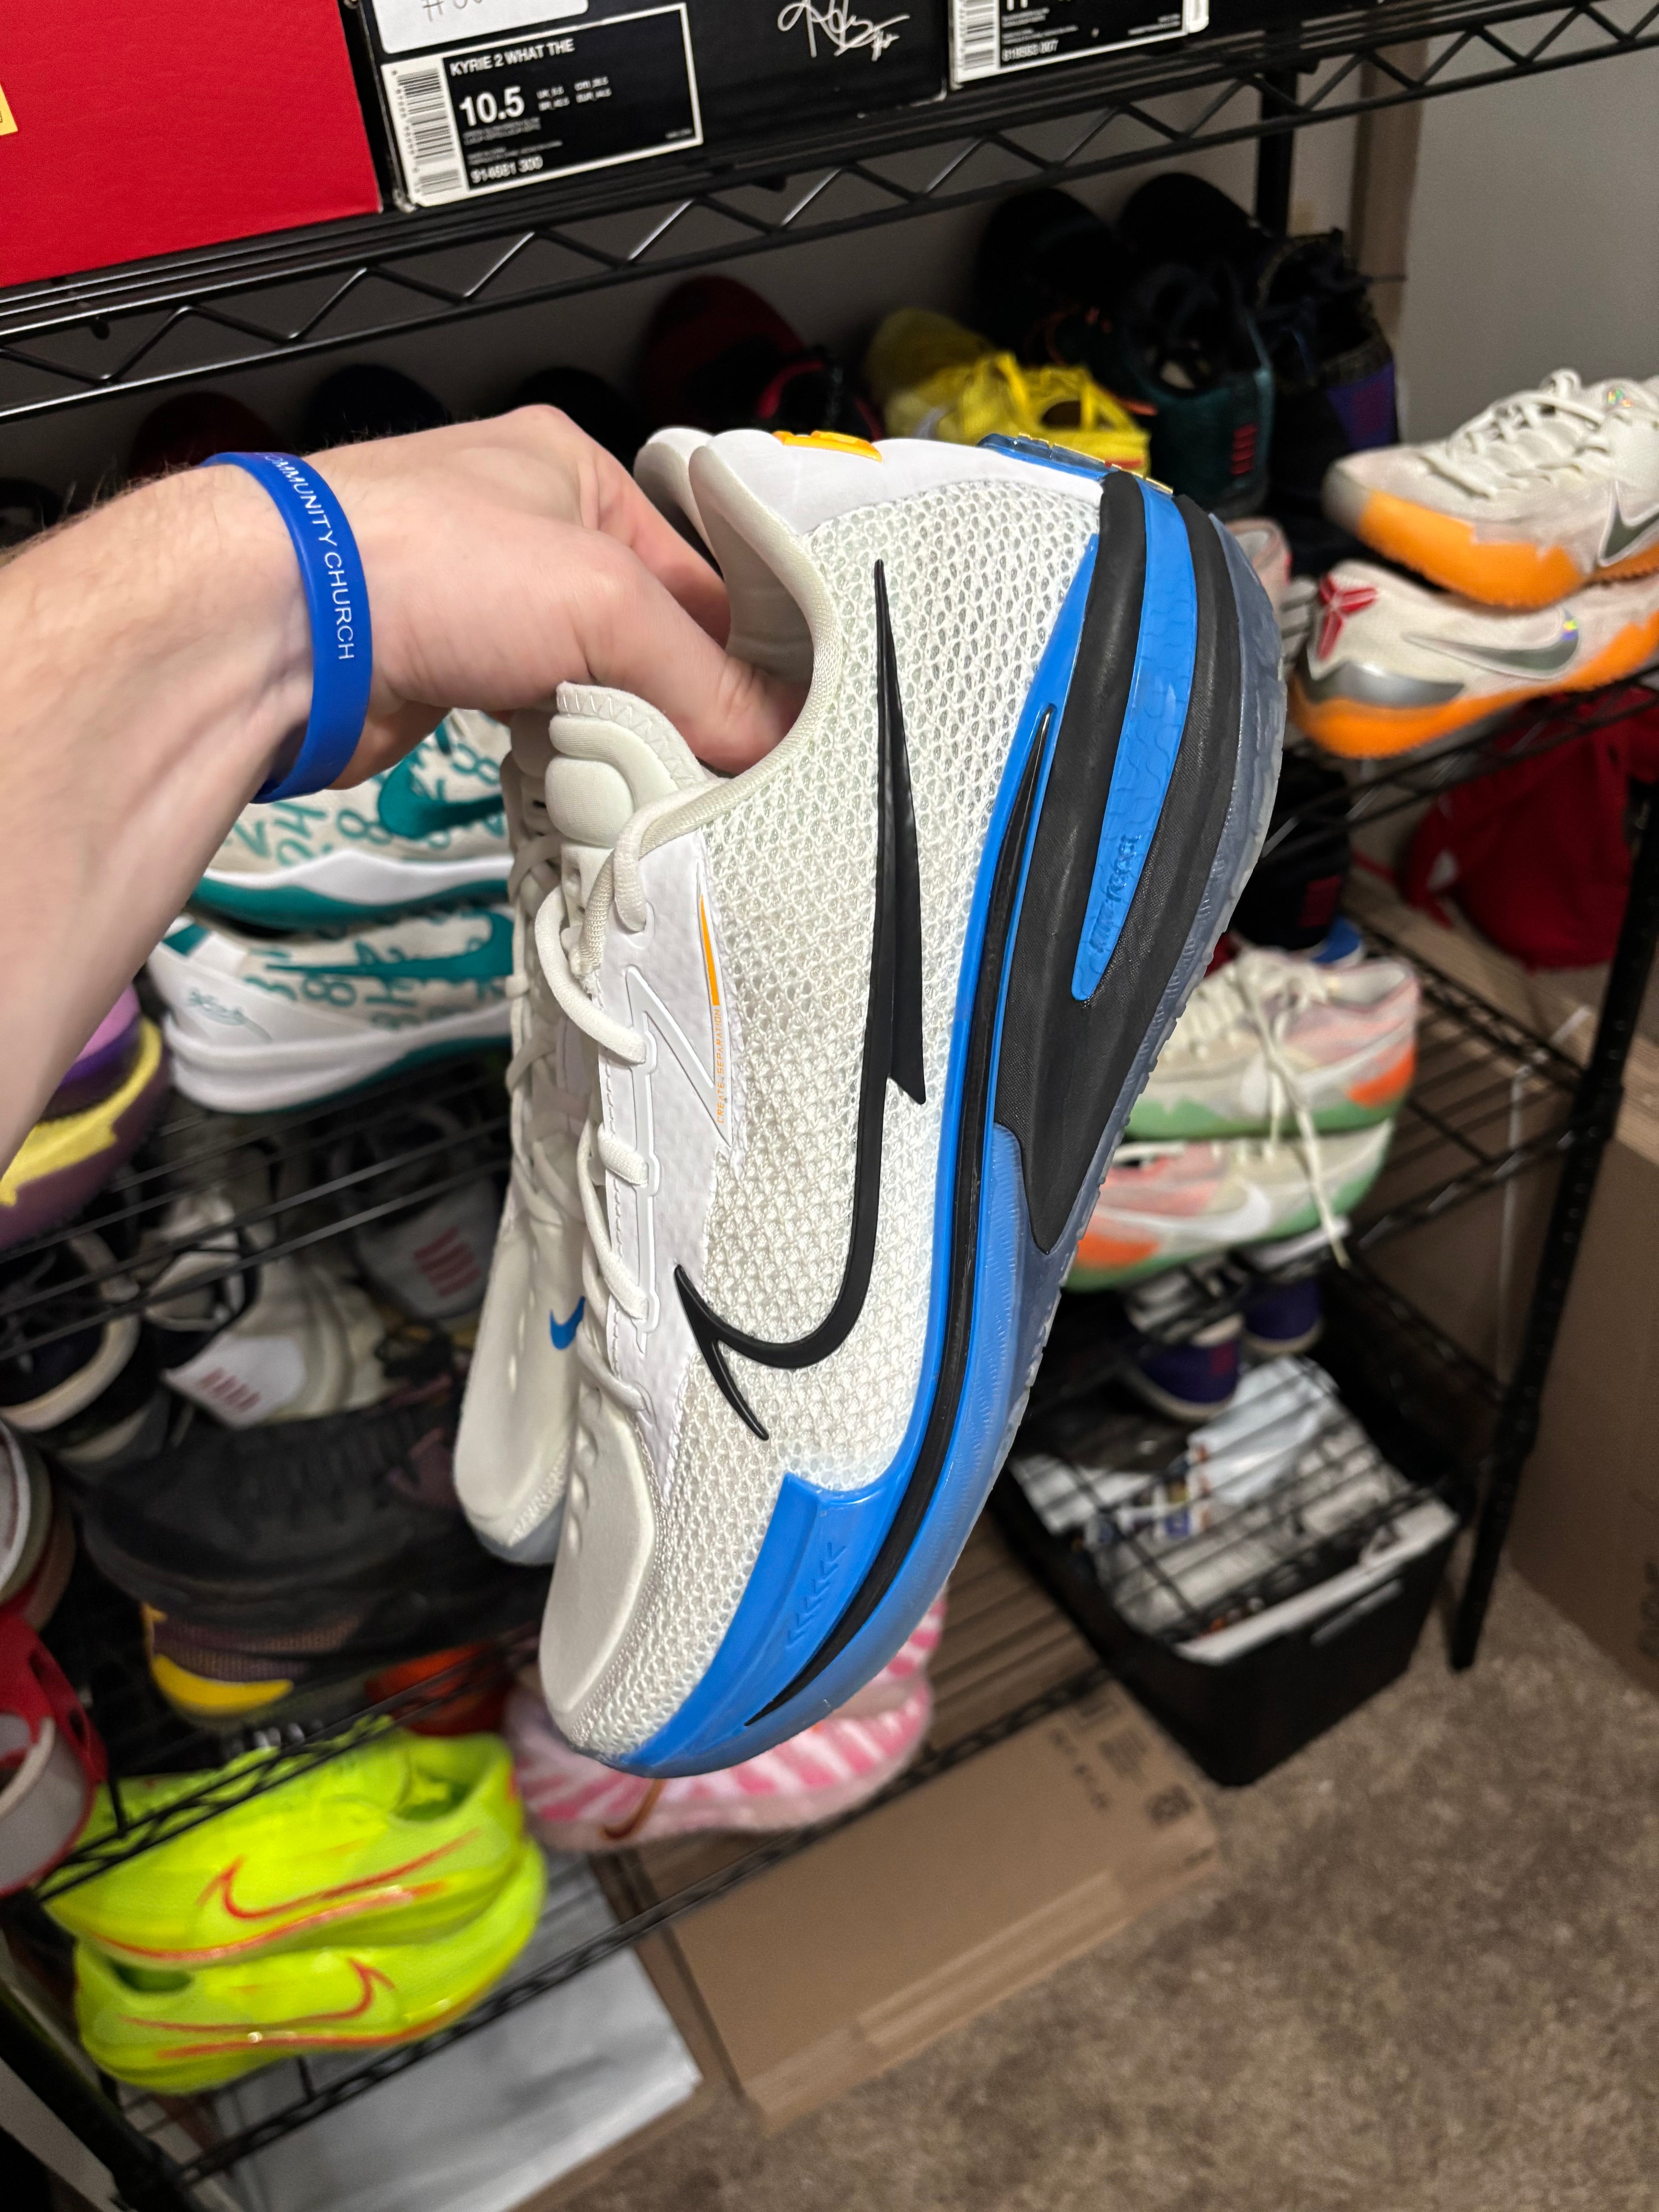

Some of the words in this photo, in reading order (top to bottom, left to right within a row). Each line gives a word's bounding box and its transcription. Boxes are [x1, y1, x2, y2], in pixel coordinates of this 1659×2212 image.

[450, 55, 493, 76] KYRIE
[494, 53, 504, 67] 2
[504, 44, 544, 65] WHAT
[545, 38, 575, 57] THE
[459, 85, 525, 127] 10.5
[255, 453, 337, 546] OMMUNITY
[324, 551, 354, 660] CHURCH
[714, 1008, 724, 1075] SEPARATION
